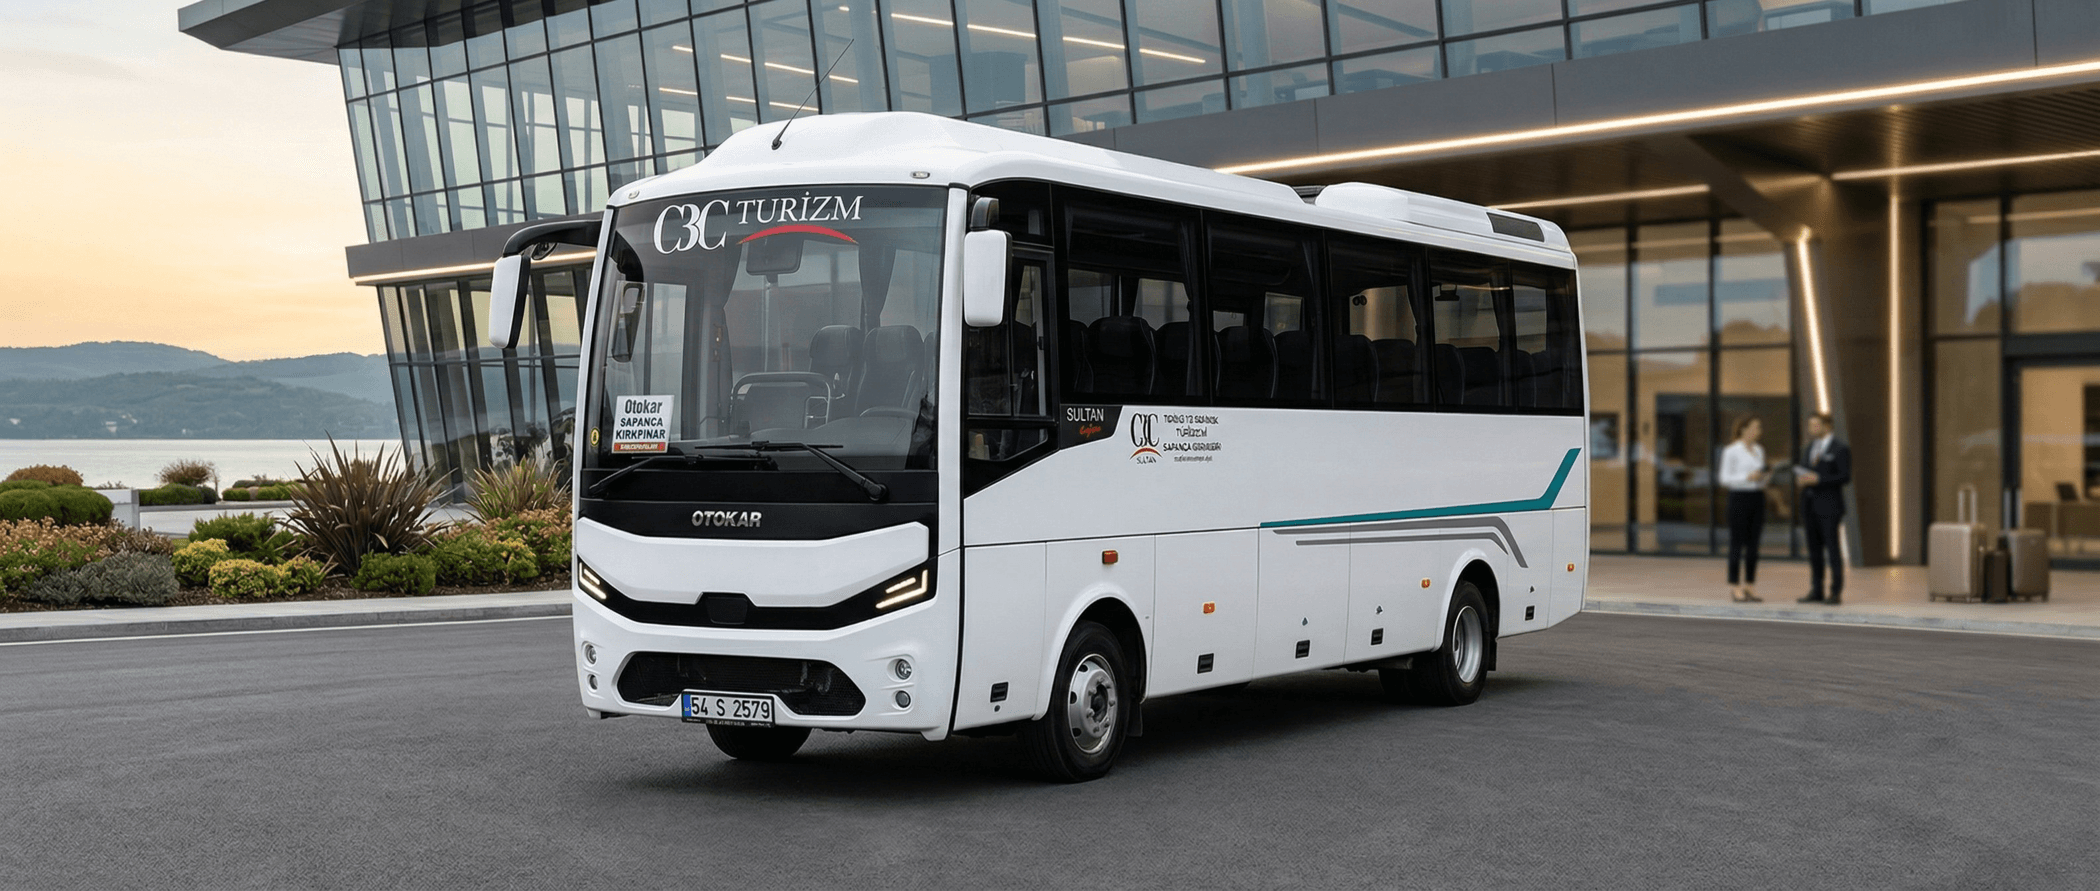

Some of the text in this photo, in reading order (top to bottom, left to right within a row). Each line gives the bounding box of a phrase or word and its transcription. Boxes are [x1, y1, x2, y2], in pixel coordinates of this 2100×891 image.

[736, 191, 864, 225] TURİZM
[625, 399, 663, 414] Otokar
[620, 417, 663, 427] SAPANCA
[1066, 407, 1104, 422] SULTAN
[615, 429, 666, 440] KIRKPINAR
[691, 510, 762, 527] OTOKAR
[691, 697, 770, 719] 54 S 2579
